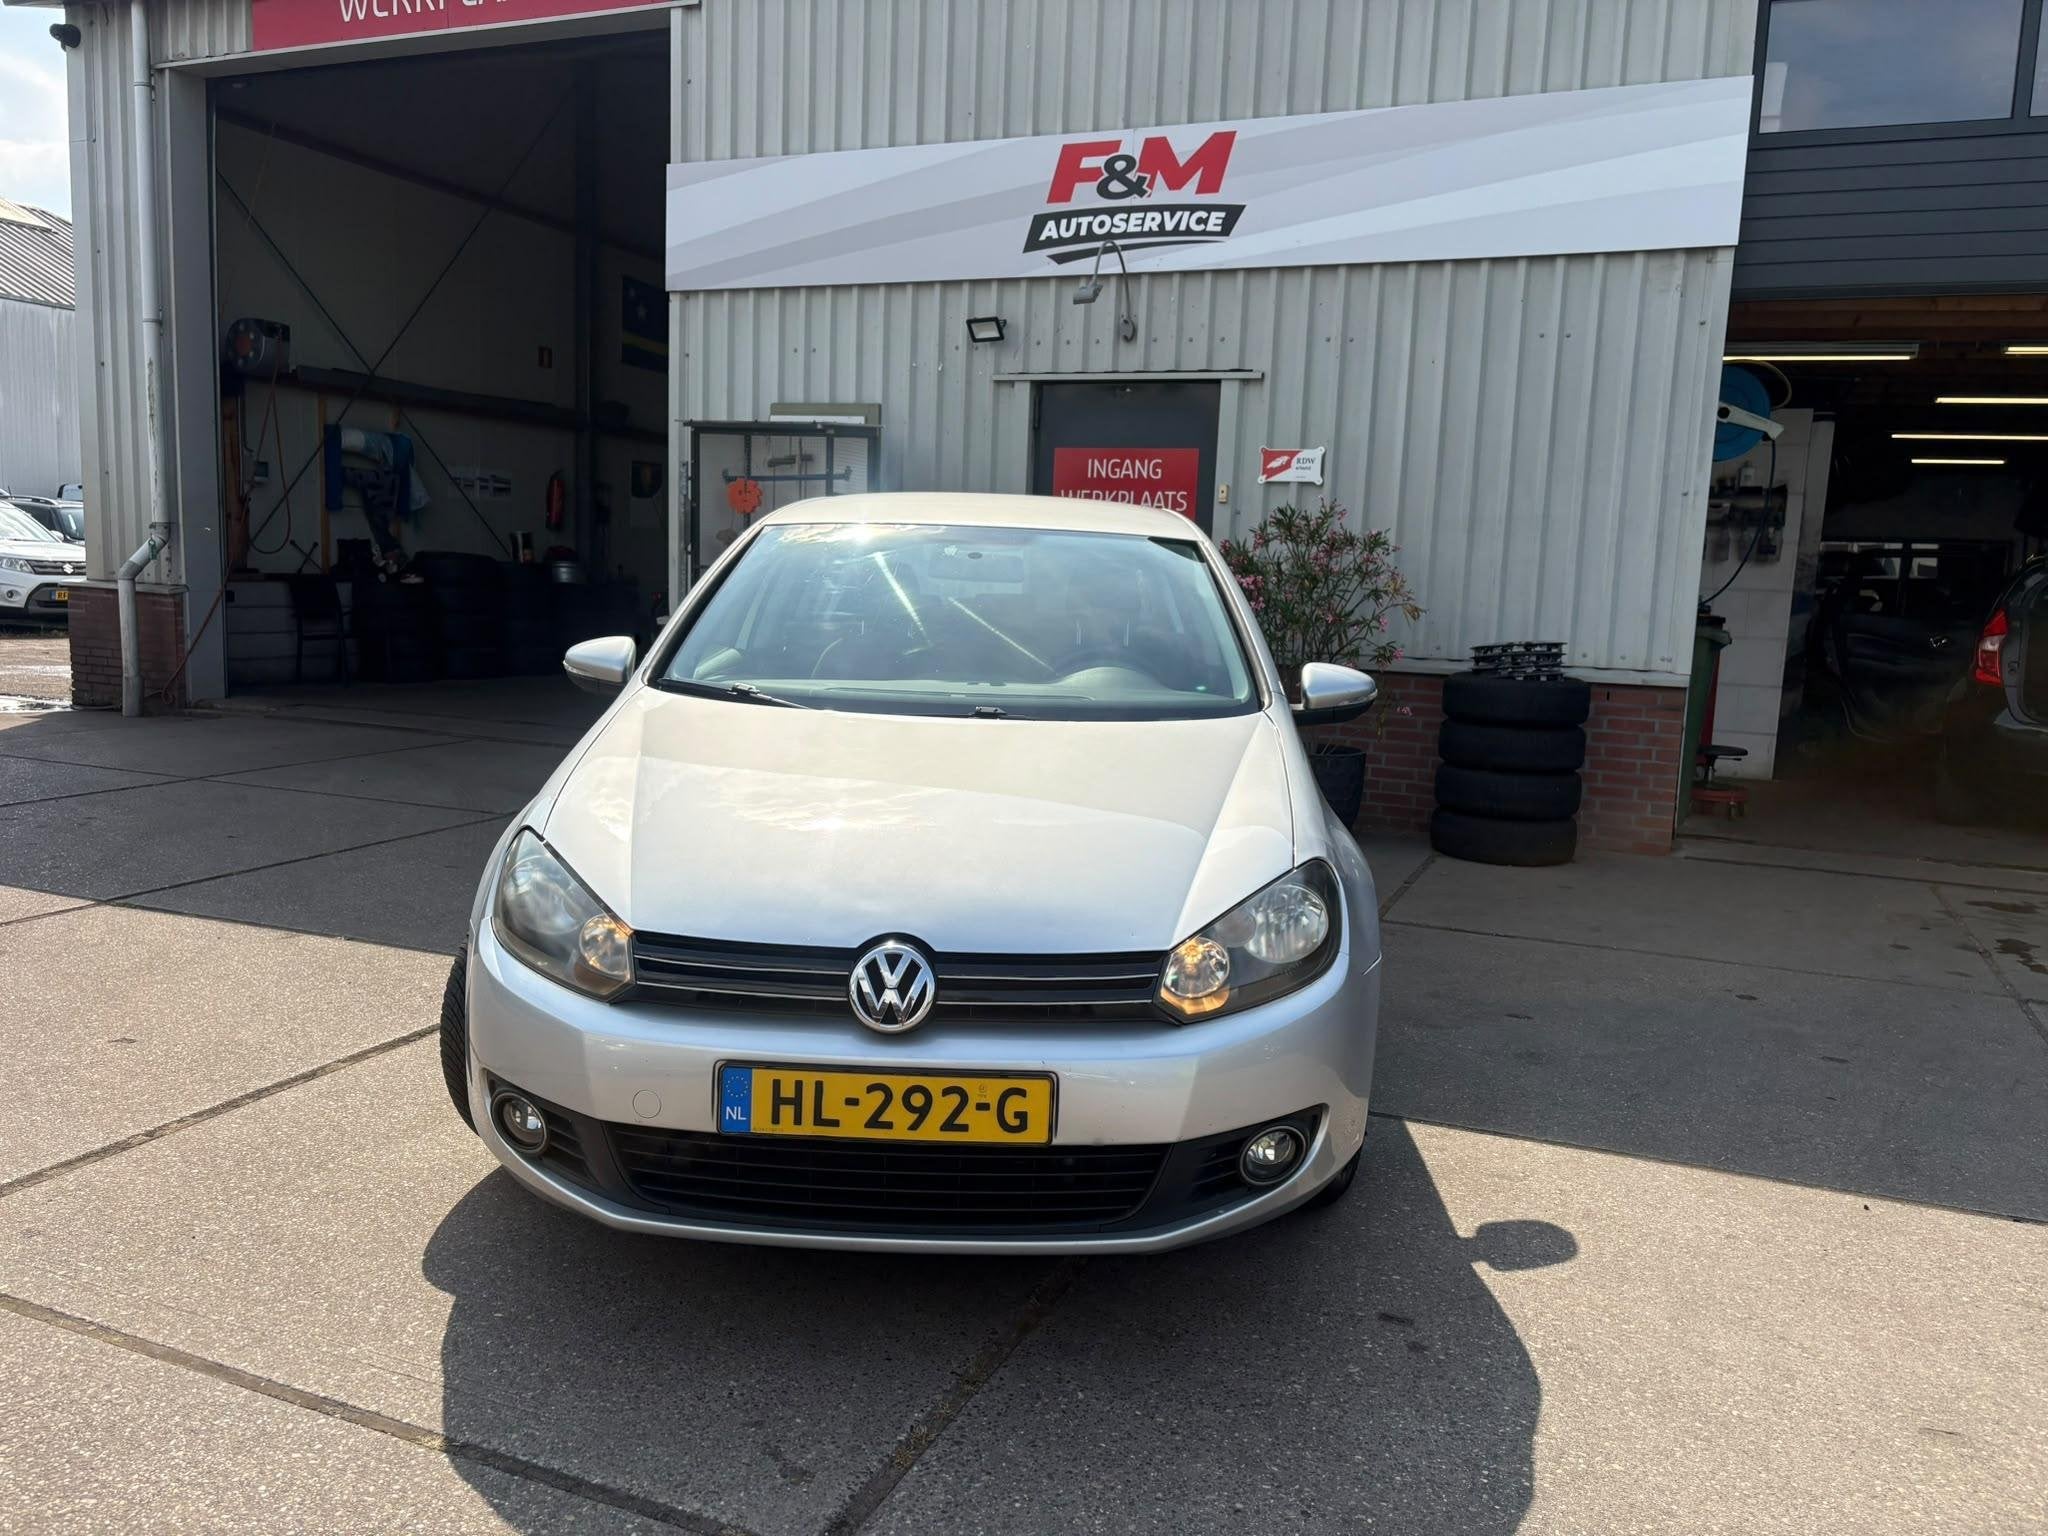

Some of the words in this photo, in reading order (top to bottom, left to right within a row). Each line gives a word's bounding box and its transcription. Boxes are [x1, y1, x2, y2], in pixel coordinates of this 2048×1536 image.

[1047, 131, 1237, 204] F&M
[1038, 210, 1226, 241] AUTOSERVICE
[1087, 458, 1163, 479] INGANG
[725, 1105, 747, 1121] NL
[771, 1078, 1029, 1134] HL-292-G
